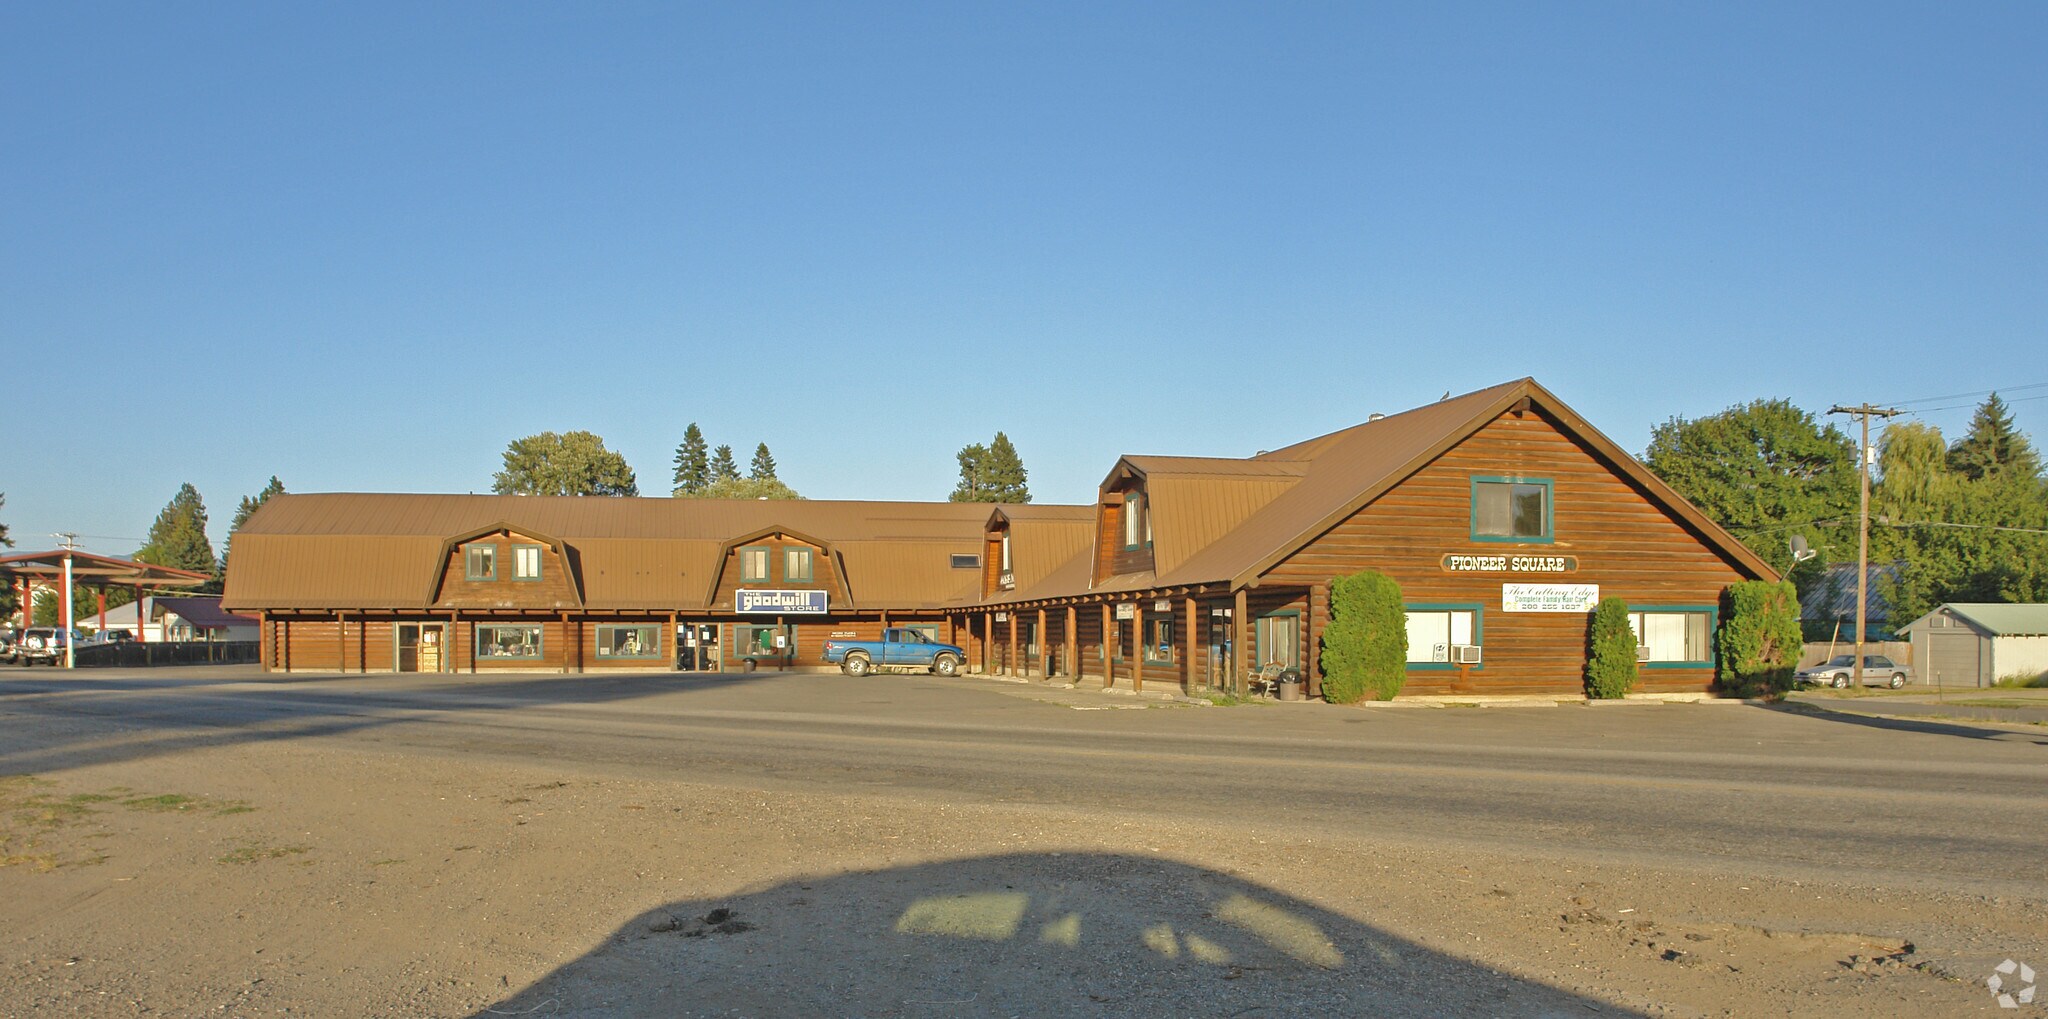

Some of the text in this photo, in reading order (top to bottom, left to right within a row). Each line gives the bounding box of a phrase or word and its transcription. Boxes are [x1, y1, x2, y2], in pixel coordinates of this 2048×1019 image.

[1450, 556, 1565, 572] PIONEER SQUARE
[1504, 585, 1596, 600] The Cutting Edge
[1514, 595, 1541, 603] Complete
[1543, 595, 1561, 603] Family
[743, 592, 811, 611] goodwill
